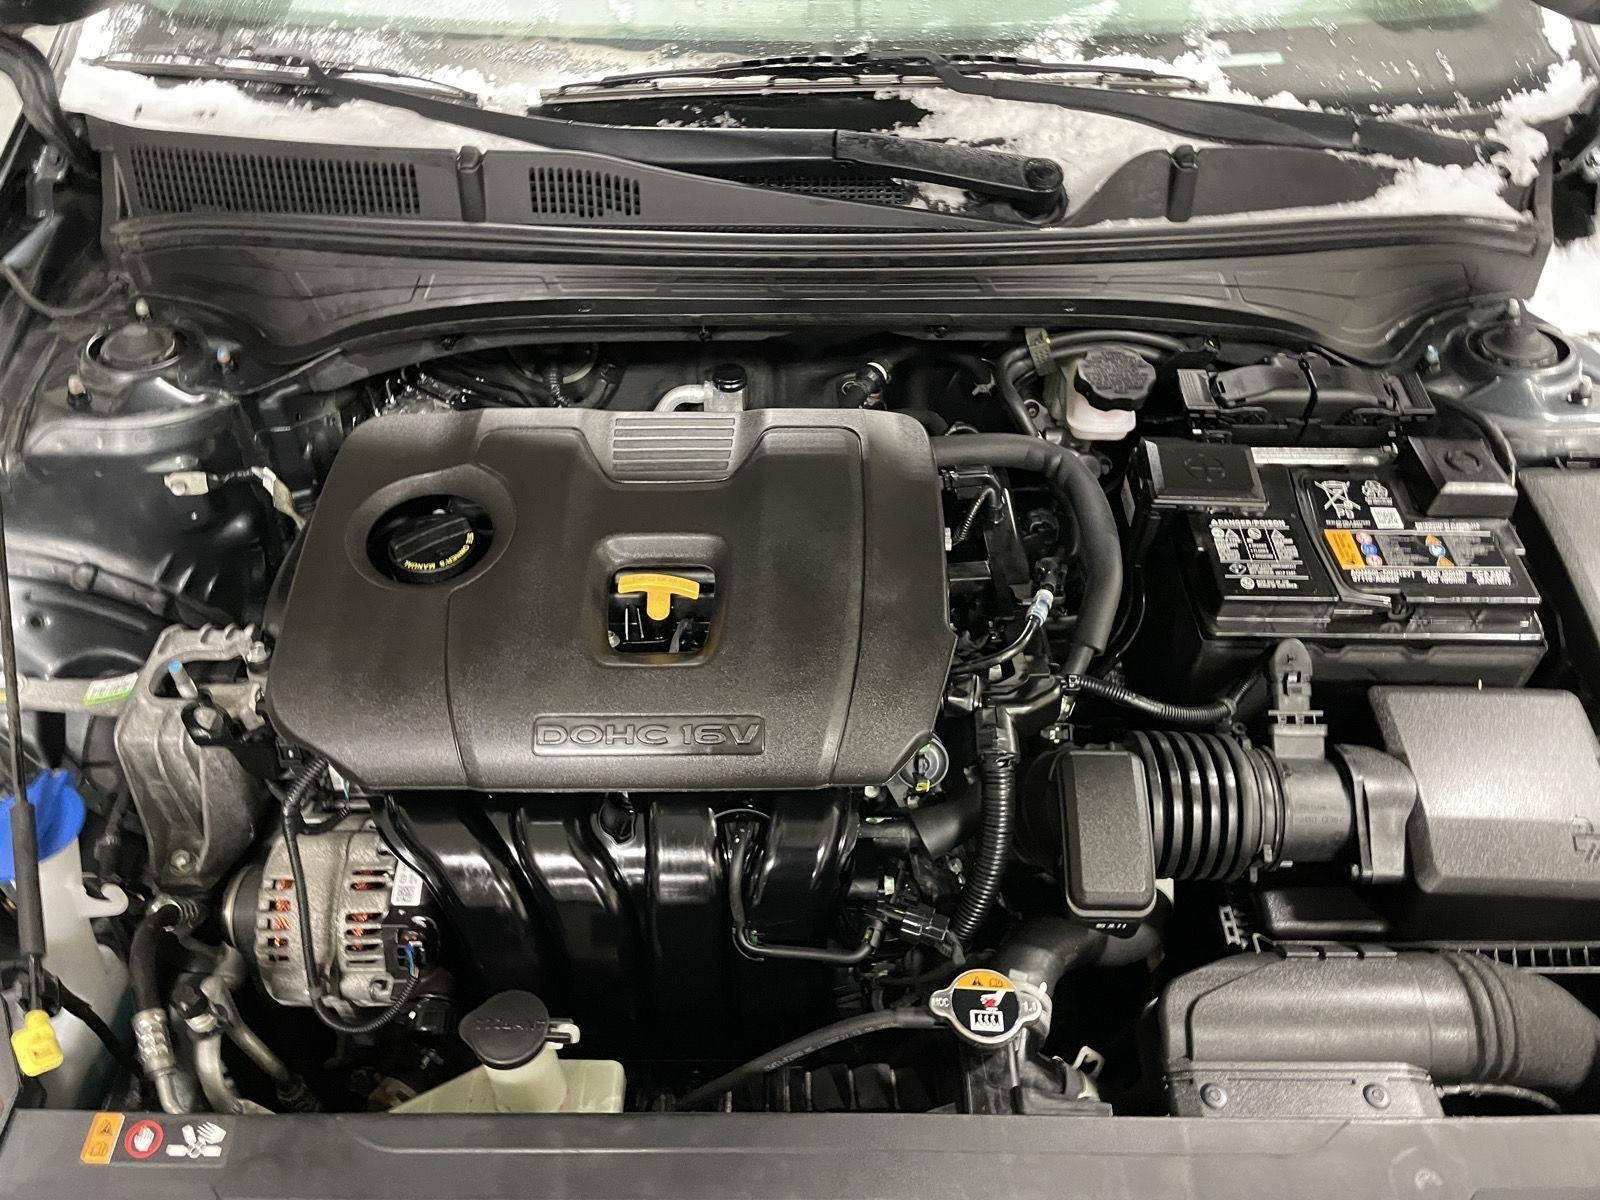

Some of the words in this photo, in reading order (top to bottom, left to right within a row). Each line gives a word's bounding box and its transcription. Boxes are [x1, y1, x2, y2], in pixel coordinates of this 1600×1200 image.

[404, 560, 436, 570] MANUAL
[535, 724, 669, 746] DOHC
[682, 724, 761, 746] 16V
